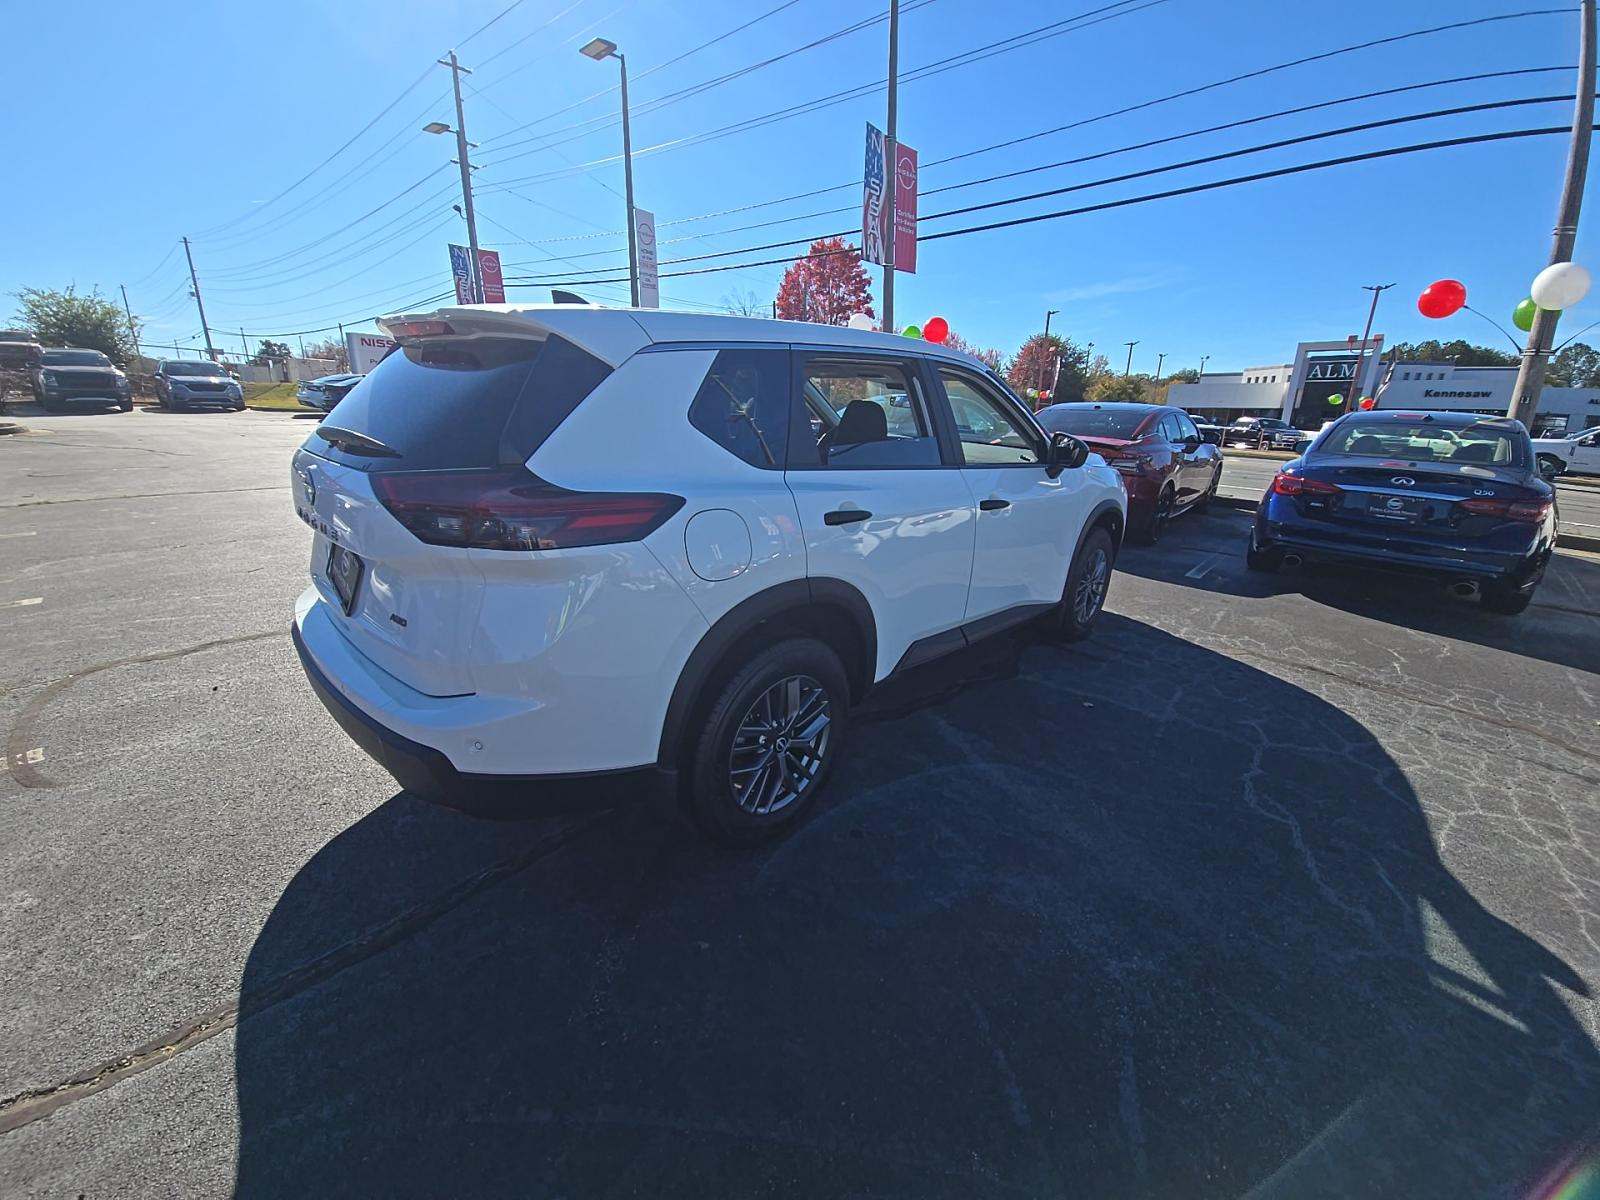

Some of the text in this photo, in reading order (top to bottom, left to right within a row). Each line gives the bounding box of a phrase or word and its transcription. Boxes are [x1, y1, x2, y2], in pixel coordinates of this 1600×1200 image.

[867, 132, 882, 259] NISSAN
[1308, 364, 1358, 378] ALM
[1424, 389, 1492, 398] Kennesaw
